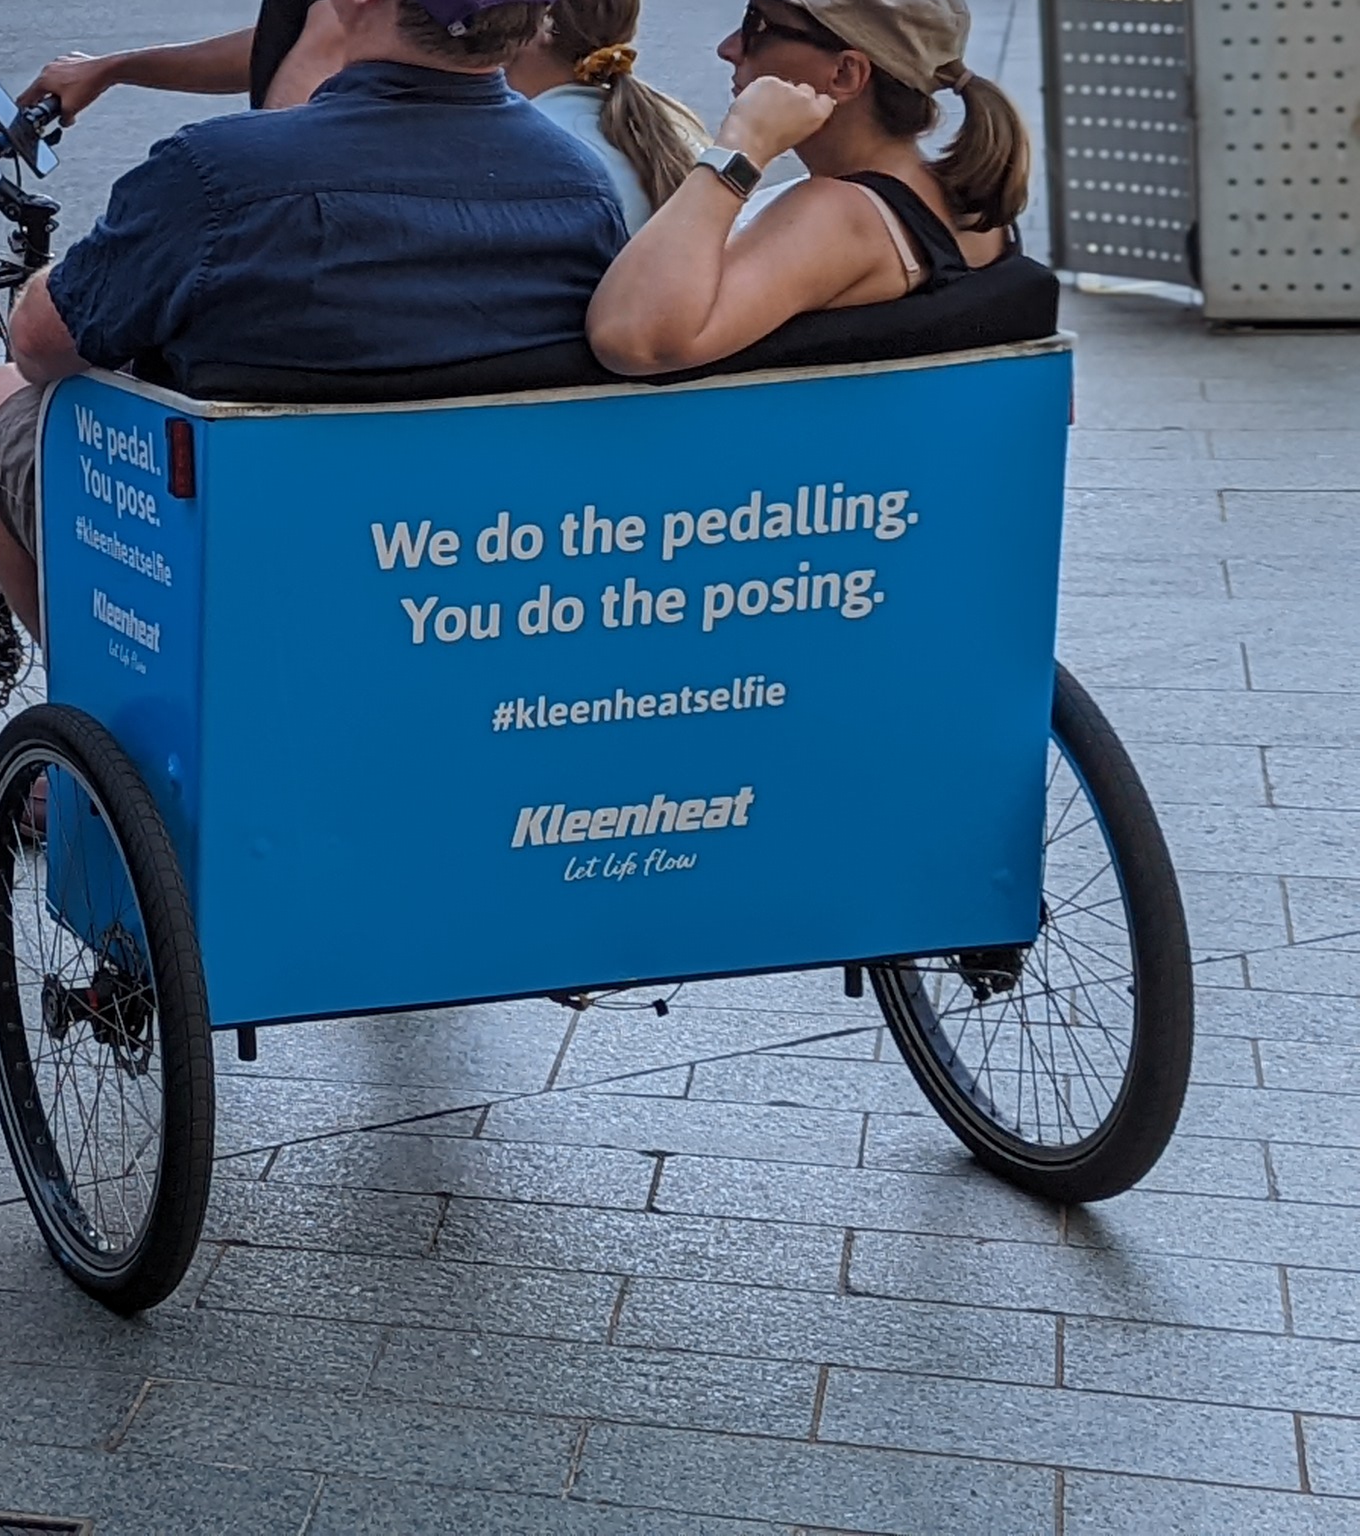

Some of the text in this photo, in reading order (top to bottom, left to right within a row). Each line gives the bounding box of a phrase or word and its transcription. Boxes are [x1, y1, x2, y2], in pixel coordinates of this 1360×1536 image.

[73, 402, 163, 477] We pedal.
[80, 453, 162, 528] You pose.
[370, 481, 919, 571] We do the pedalling.
[74, 514, 173, 587] #kleenheatselfie
[92, 587, 161, 654] Kleenheat
[399, 560, 885, 645] You do the posing.
[491, 675, 787, 732] #kleenheatselfie
[510, 786, 756, 849] Kleenheat
